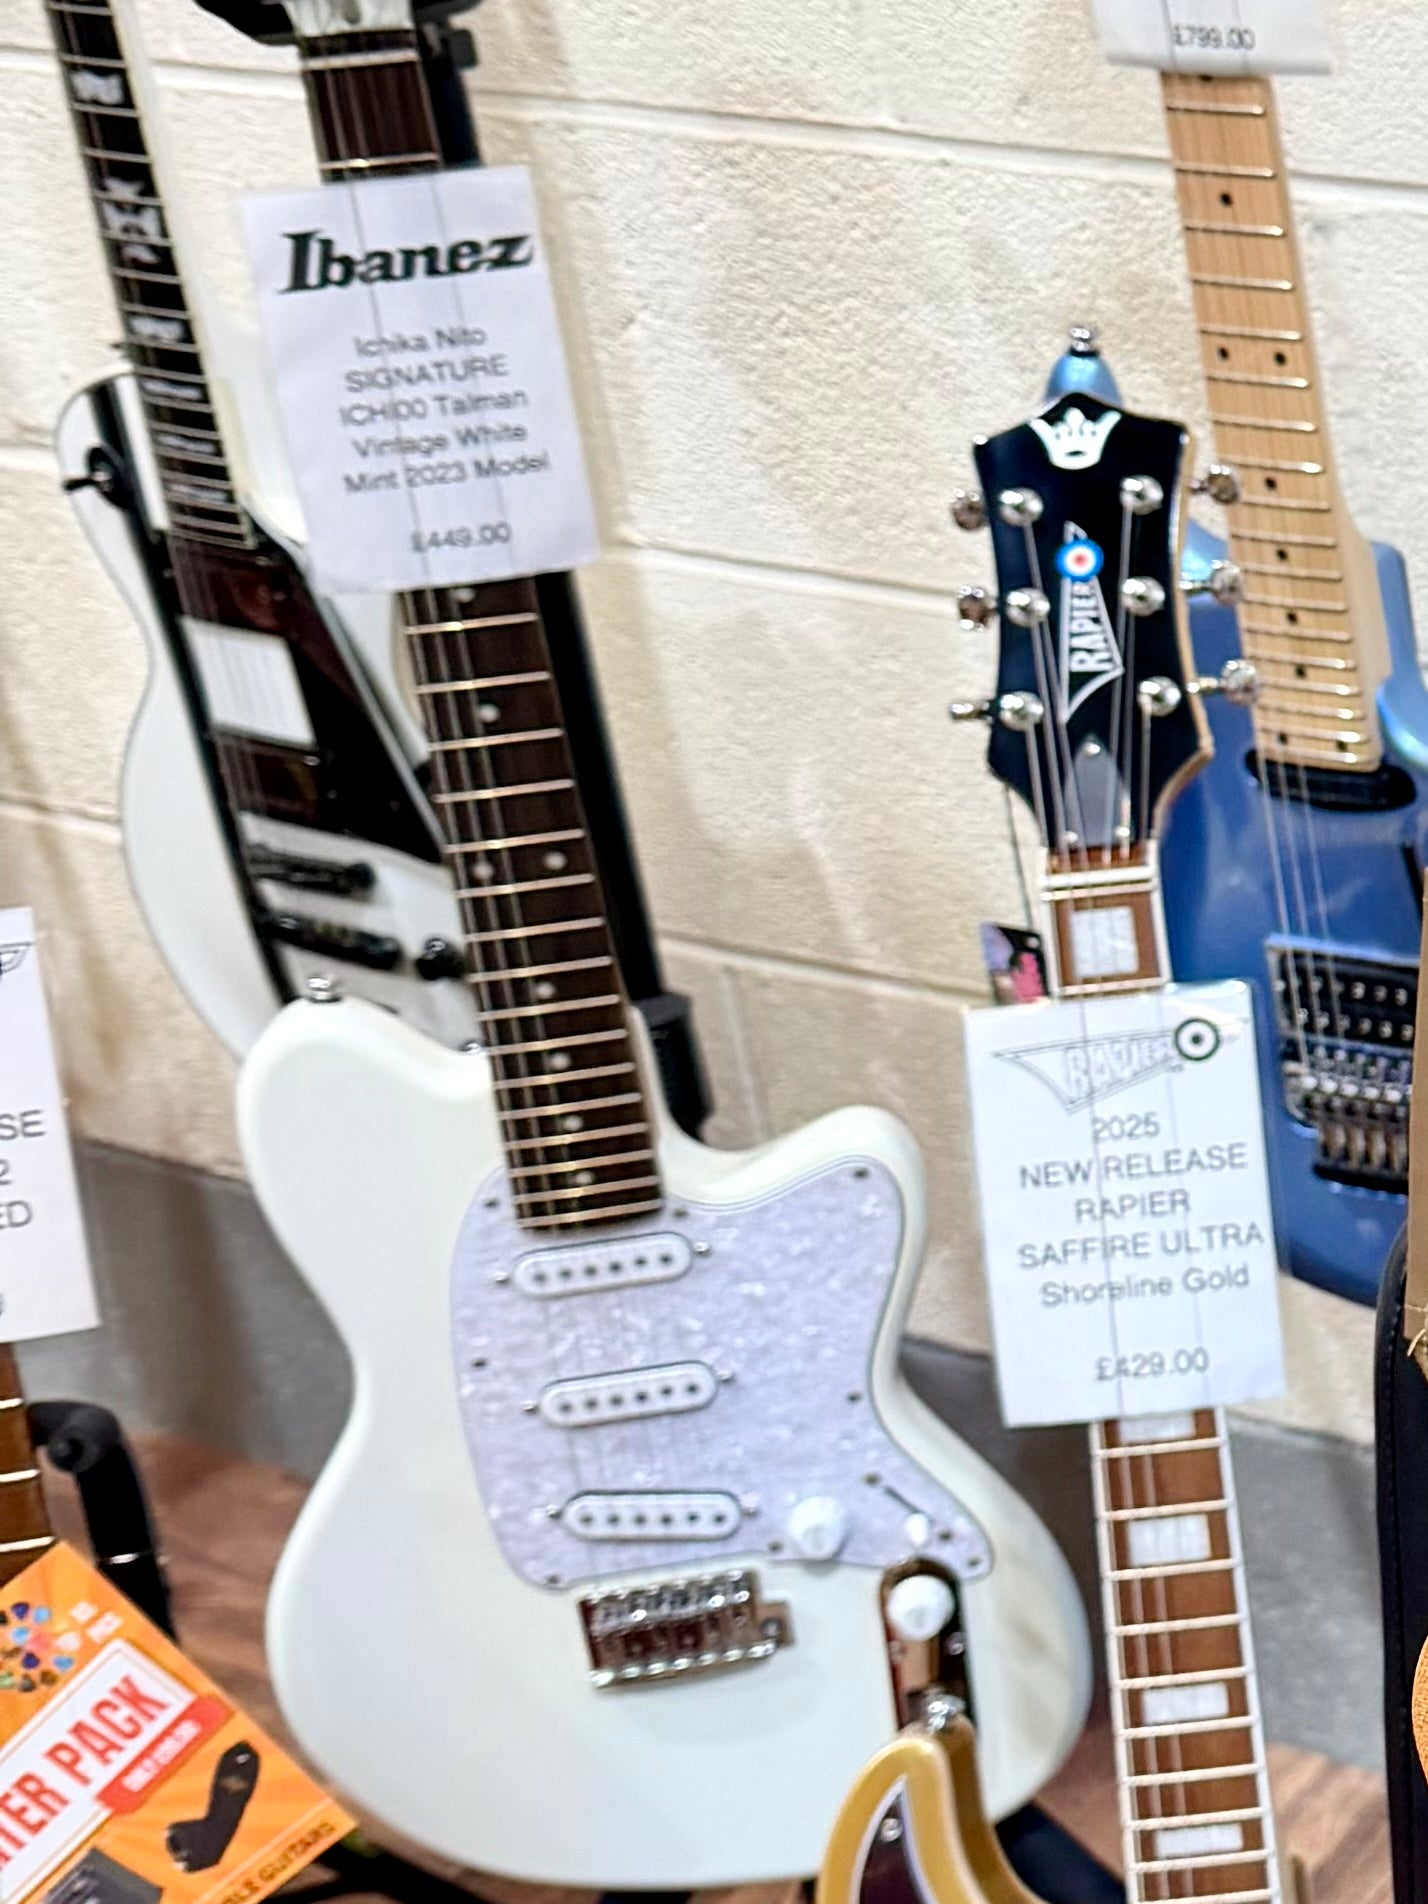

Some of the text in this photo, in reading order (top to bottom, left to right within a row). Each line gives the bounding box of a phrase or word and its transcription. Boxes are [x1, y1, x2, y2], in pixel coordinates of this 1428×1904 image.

[278, 229, 534, 295] Ibanez
[353, 324, 488, 358] Ichika Nito
[344, 354, 510, 393] SIGNATURE
[438, 389, 529, 417] Talman
[352, 423, 527, 462] Vintage White
[344, 451, 551, 495] Mint 2023 Model
[1093, 1111, 1160, 1142] 2025
[1018, 1143, 1249, 1189] NEW RELEASE
[1074, 1189, 1191, 1224] RAPIER
[1018, 1222, 1265, 1269] SAFFIRE ULTRA
[1041, 1265, 1250, 1308] Shoreline Gold
[1096, 1349, 1210, 1382] £429.00
[44, 1675, 170, 1787] PACK
[258, 1820, 337, 1880] GUITARS
